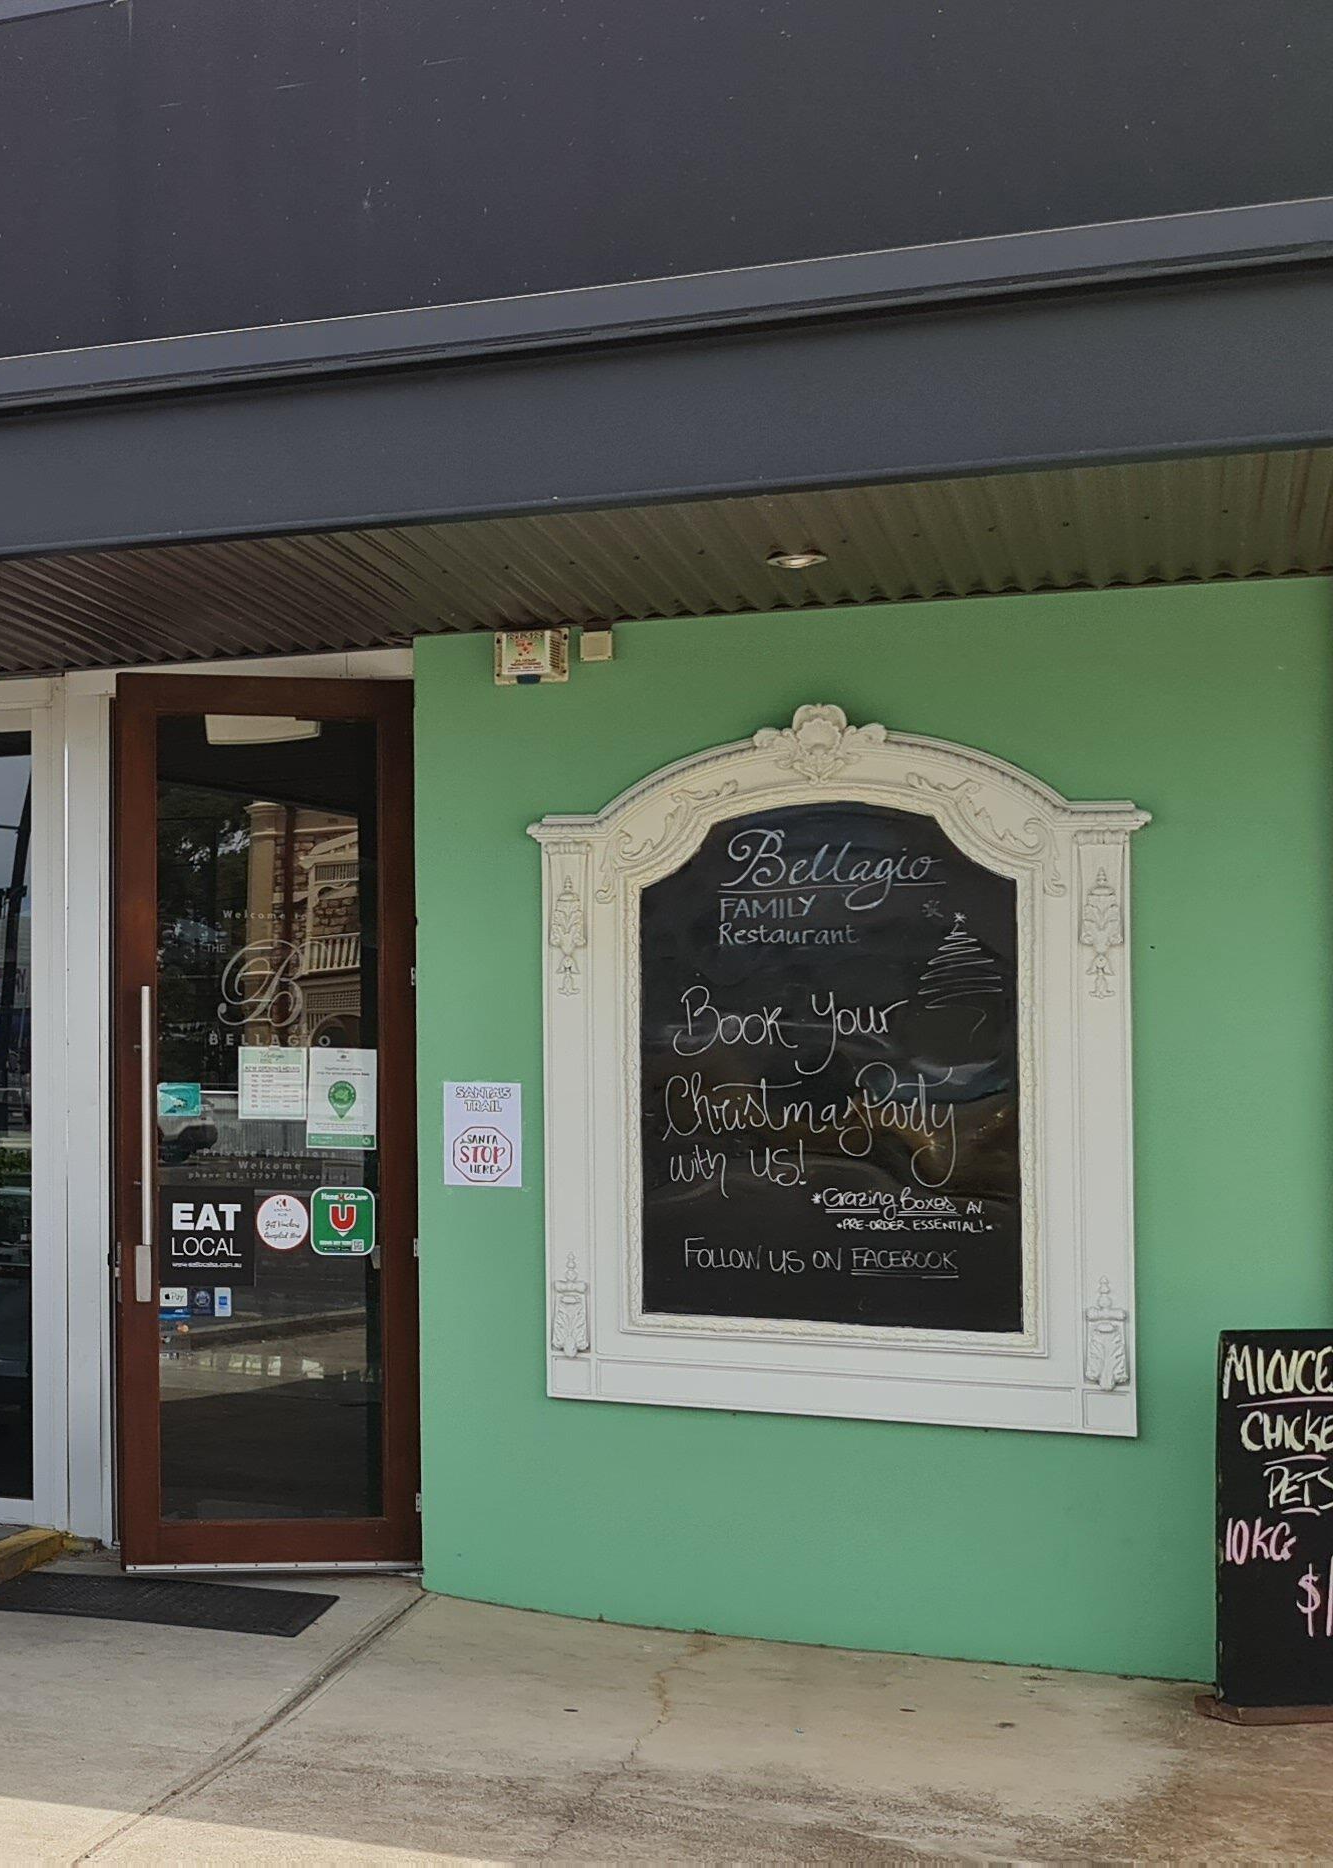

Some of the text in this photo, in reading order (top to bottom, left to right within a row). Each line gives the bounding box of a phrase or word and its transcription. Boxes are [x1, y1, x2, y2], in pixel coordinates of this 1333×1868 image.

[721, 829, 943, 910] Bellagio
[720, 894, 816, 922] FAMILY
[718, 922, 860, 945] Restaurant
[206, 943, 227, 954] THE
[673, 986, 798, 1056] Book
[209, 1034, 331, 1047] BELLAGO
[464, 1100, 502, 1112] TRAIL
[663, 1062, 956, 1187] Christmas Party
[466, 1135, 498, 1144] SANTA
[238, 1161, 301, 1170] Welcome
[460, 1145, 505, 1164] STOP
[671, 1145, 728, 1198] with
[172, 1203, 241, 1231] EAT
[171, 1237, 242, 1256] LOCAL
[812, 1248, 842, 1270] ON
[851, 1248, 958, 1270] FACEBOOK
